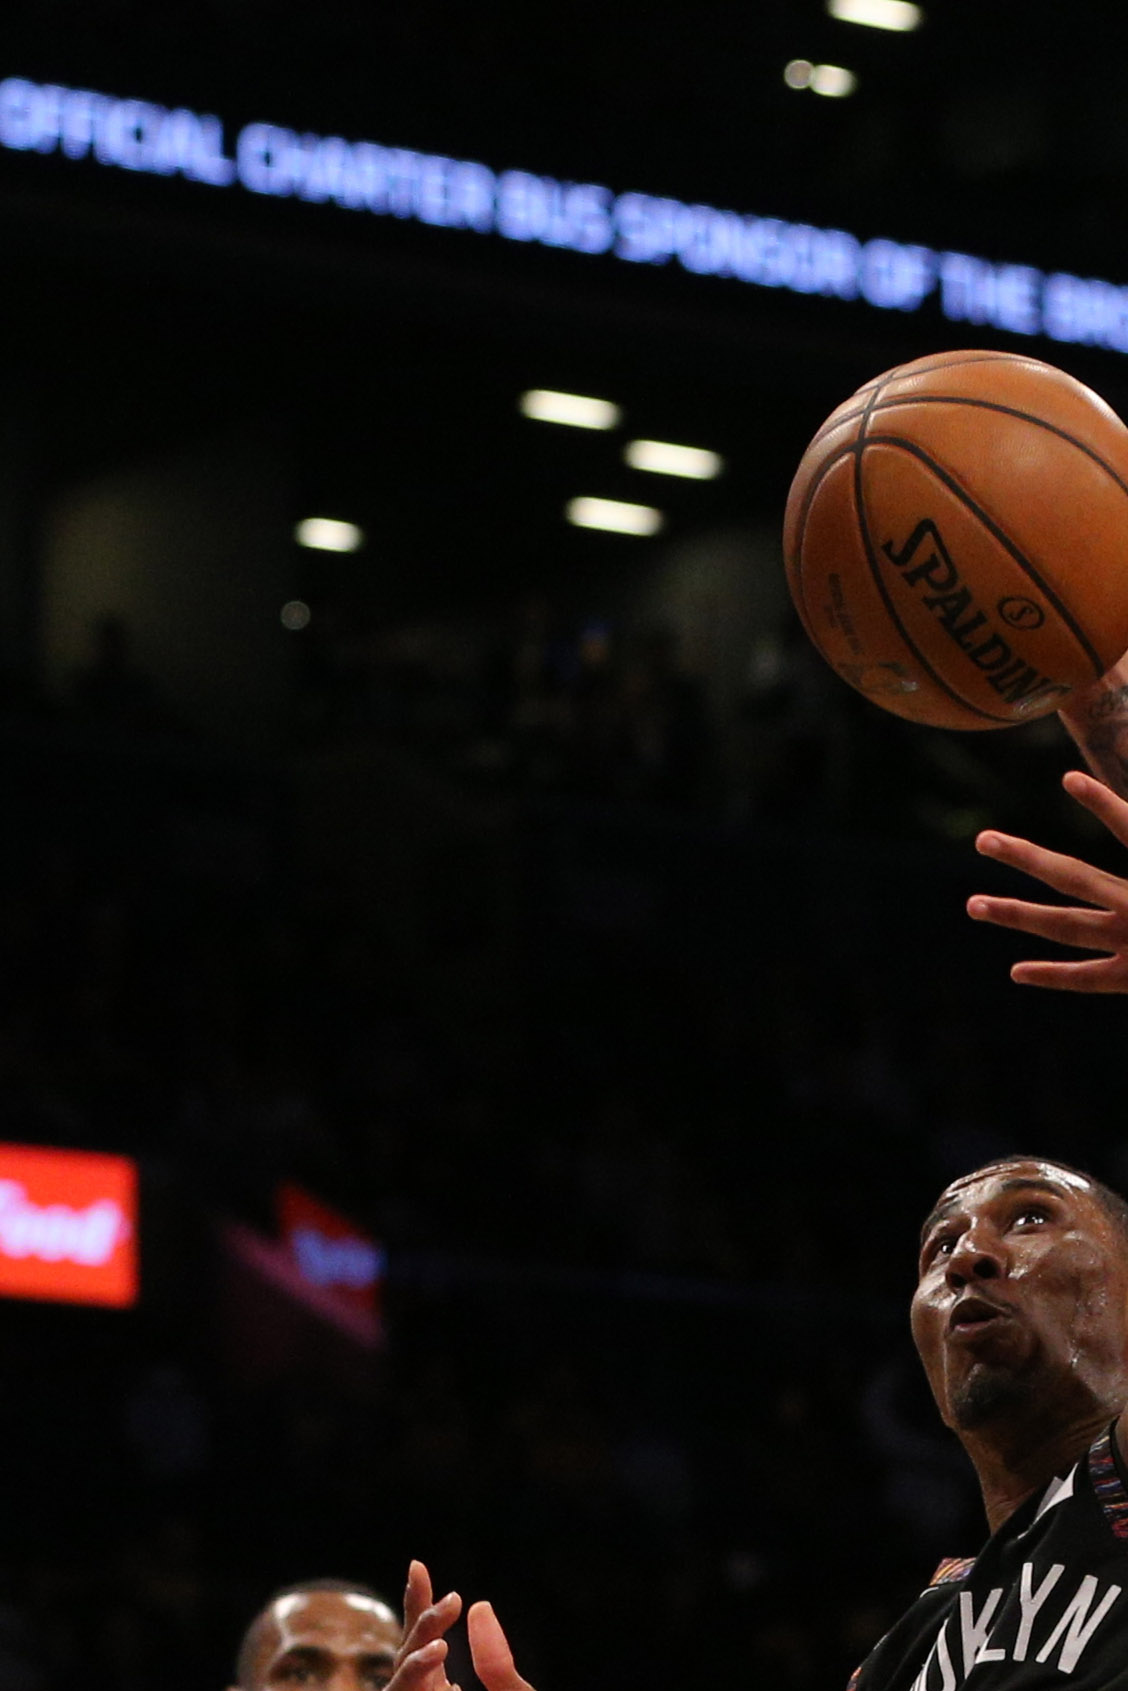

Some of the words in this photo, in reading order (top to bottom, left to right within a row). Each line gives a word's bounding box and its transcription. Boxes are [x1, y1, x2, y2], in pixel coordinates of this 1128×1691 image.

[0, 77, 237, 186] OFFICIAL
[237, 122, 498, 233] CHARTER
[498, 169, 613, 255] BUS
[613, 191, 861, 300] SPONSOR
[859, 237, 938, 311] OF
[940, 250, 1043, 336] THE
